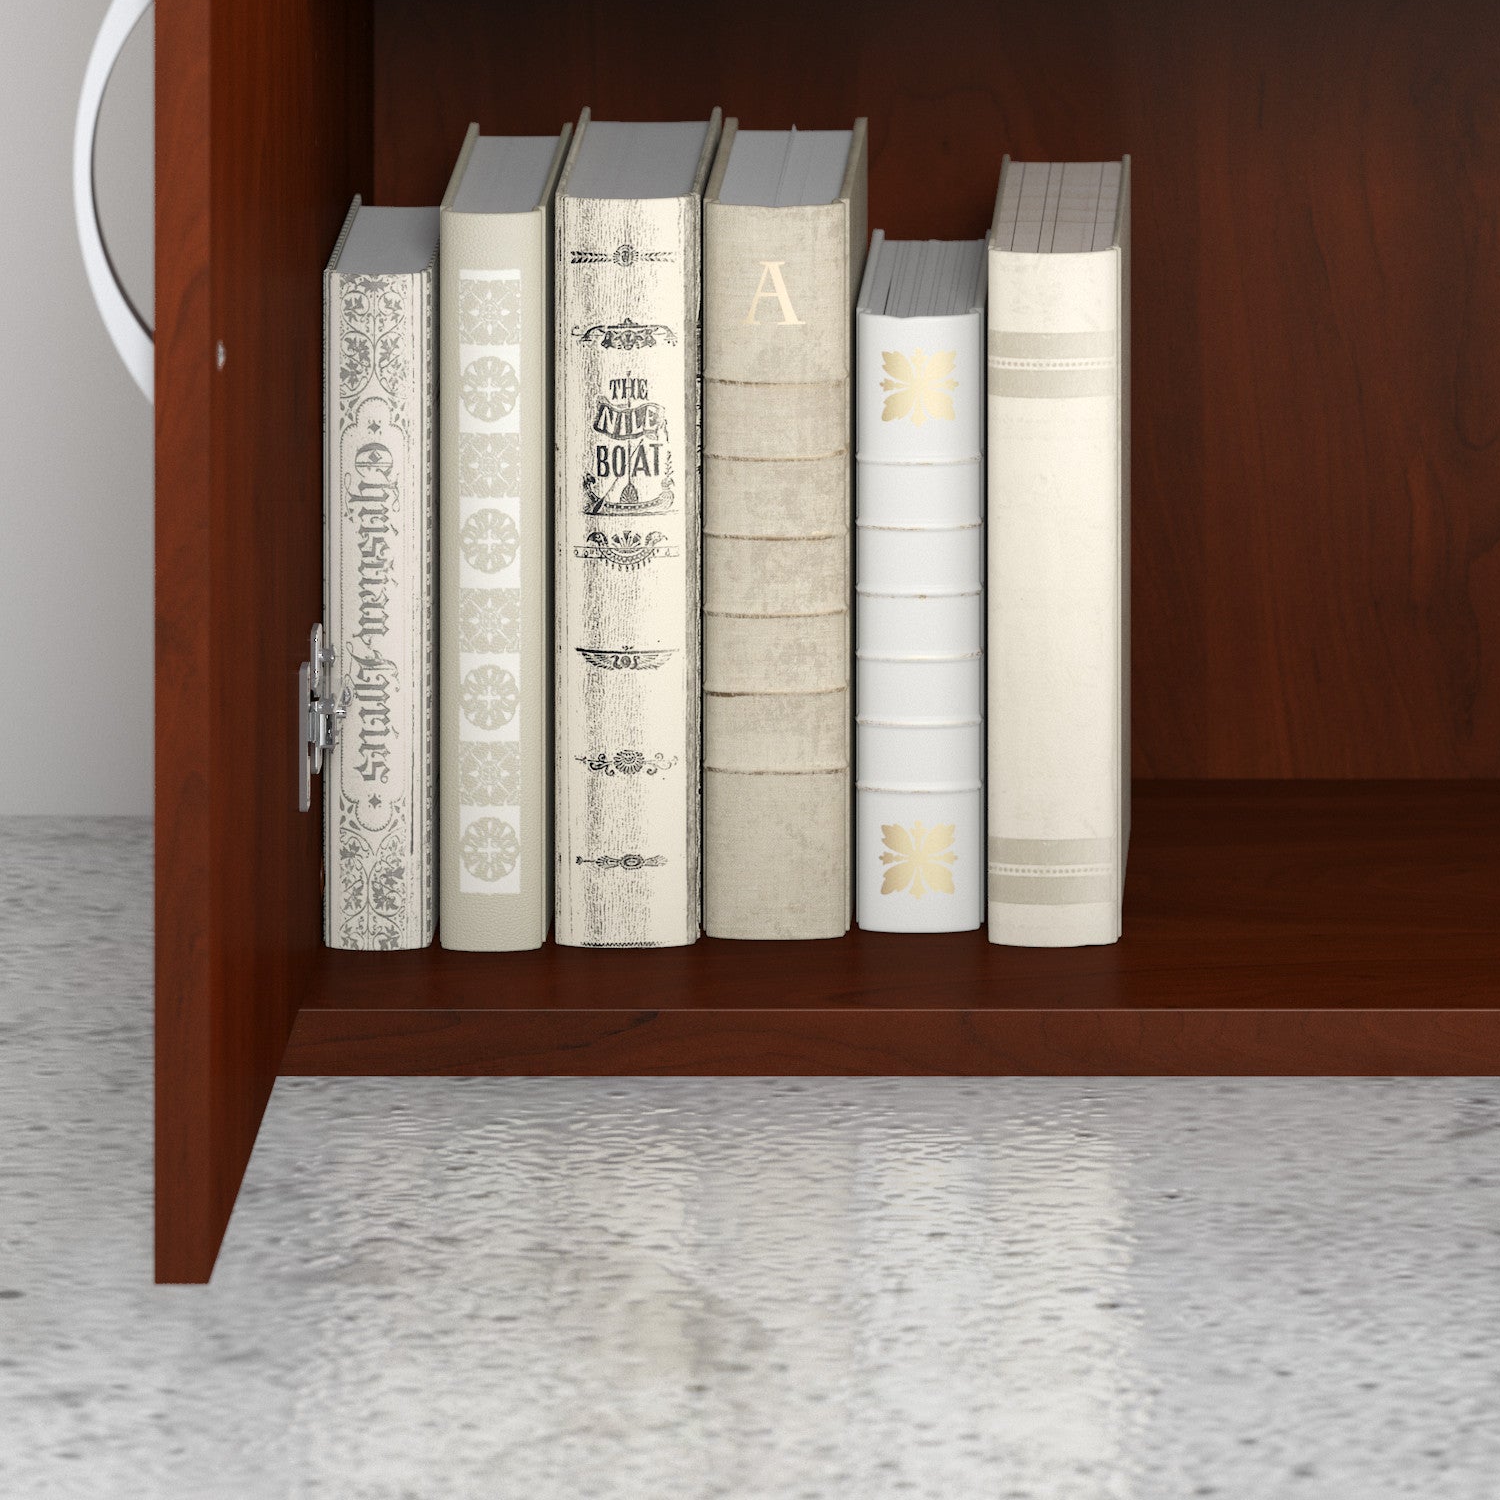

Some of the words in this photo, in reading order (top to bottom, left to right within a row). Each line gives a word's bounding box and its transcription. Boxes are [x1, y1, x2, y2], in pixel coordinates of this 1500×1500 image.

[739, 261, 806, 326] A
[609, 378, 649, 401] THE
[597, 402, 662, 436] NILE
[595, 443, 663, 478] BOAT
[343, 442, 401, 646] Christian
[343, 642, 401, 785] Lyrics
